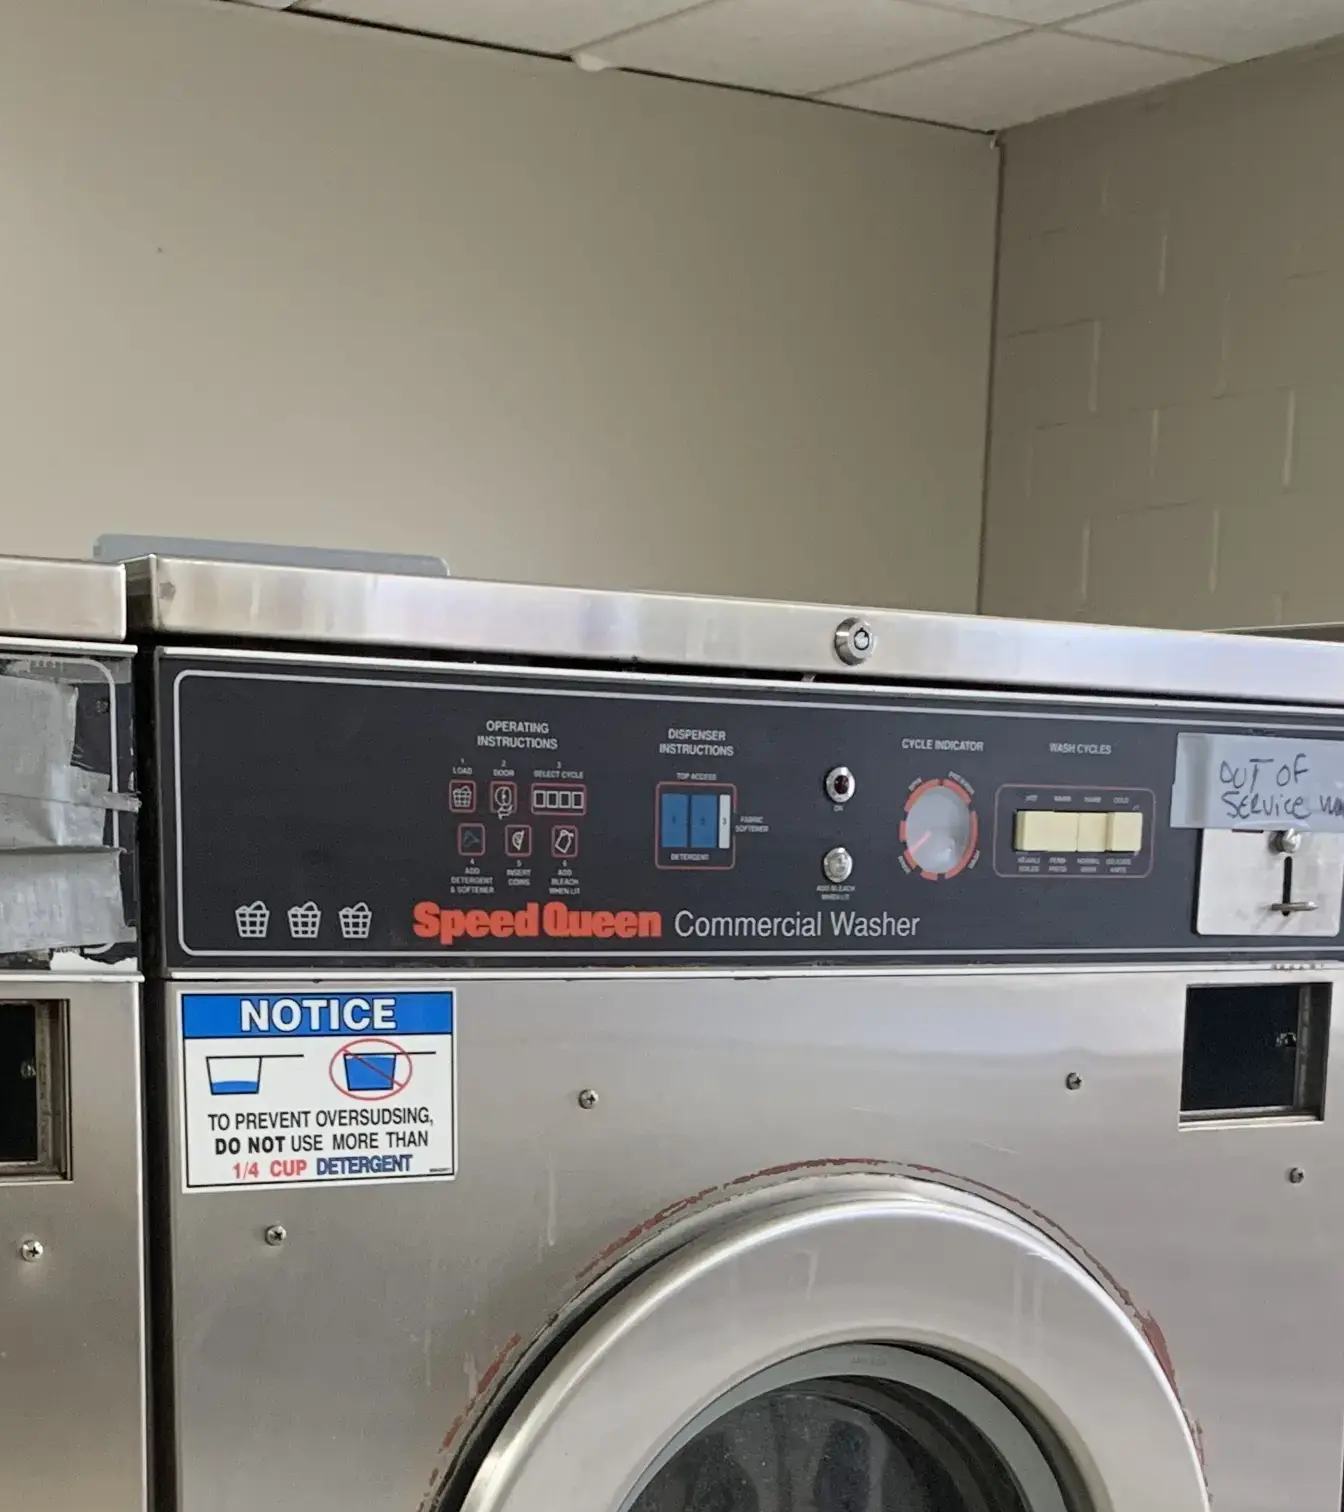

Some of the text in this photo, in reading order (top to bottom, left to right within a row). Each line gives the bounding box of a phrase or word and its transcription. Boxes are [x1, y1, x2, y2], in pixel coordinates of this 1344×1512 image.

[486, 720, 550, 734] OPERATING
[668, 729, 726, 741] DISPENSER
[477, 735, 558, 750] INSTRUCTIONS
[902, 738, 984, 752] CYCLE INDICATOR
[1049, 742, 1112, 755] WASH CYCLES
[659, 744, 734, 756] INSTRUCTIONS
[452, 767, 473, 775] LOAD
[493, 769, 515, 777] DOOR
[533, 770, 584, 779] SELECT CYCLE
[1276, 753, 1308, 786] OF
[413, 901, 921, 944] Speed Queen Commercial Washer
[240, 997, 397, 1032] NOTICE
[208, 1107, 433, 1131] TO PREVENT OVERSUDSING,
[215, 1130, 428, 1155] DO NOT USE MORE THAN
[232, 1154, 413, 1179] 1/4 CUP DETERGENT
